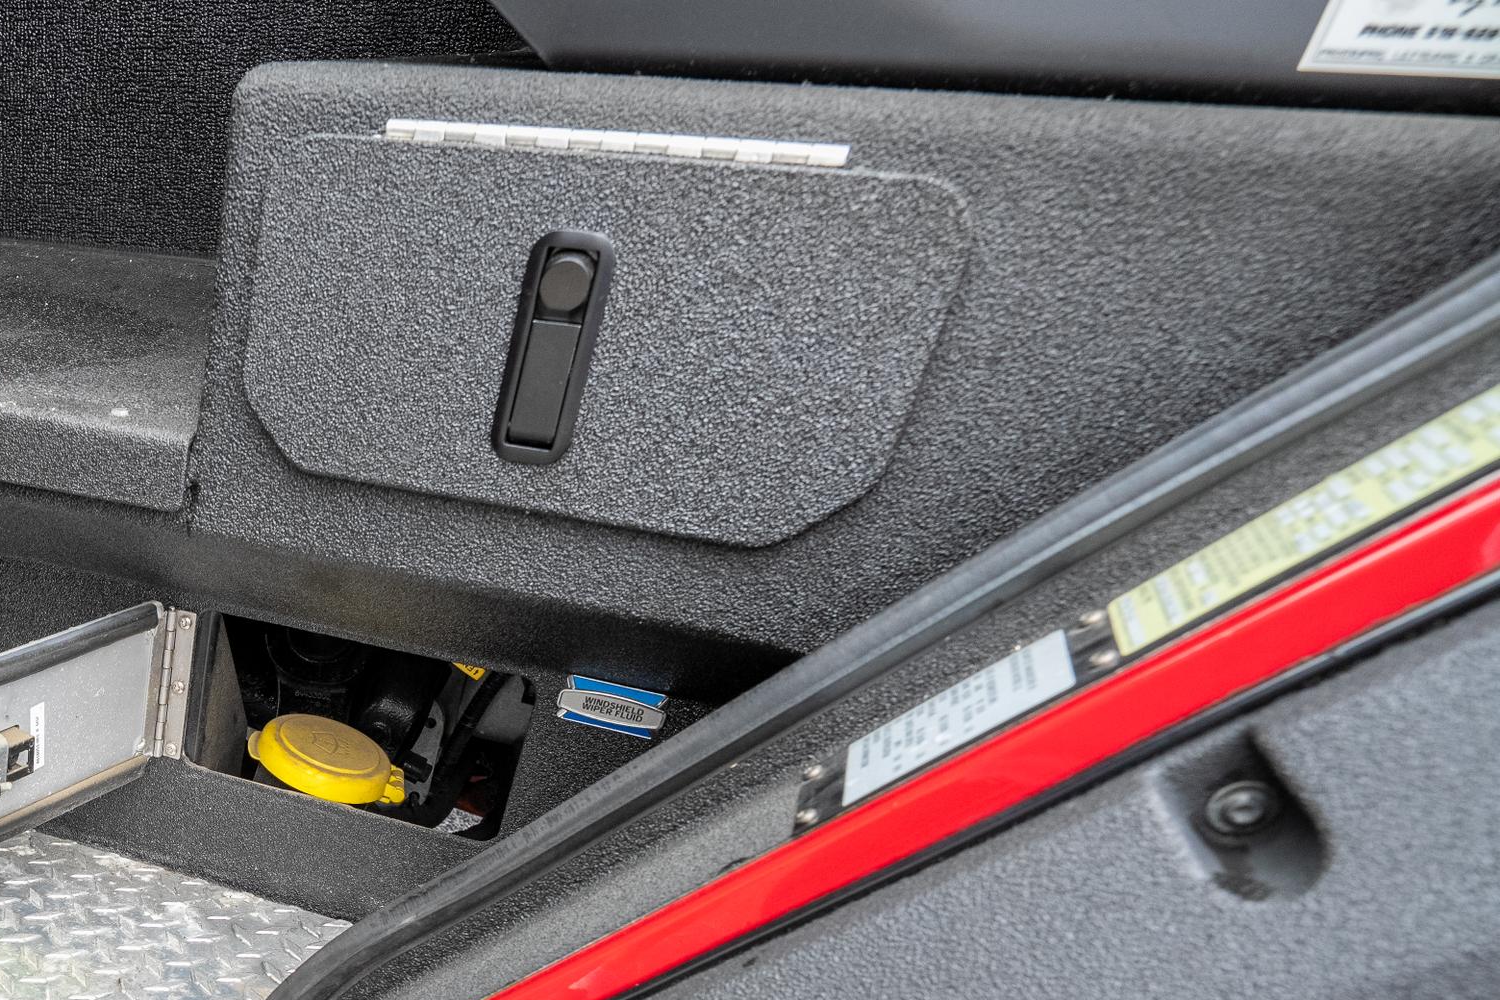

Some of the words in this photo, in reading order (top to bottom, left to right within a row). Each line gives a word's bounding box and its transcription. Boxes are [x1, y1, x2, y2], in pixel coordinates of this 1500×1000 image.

[581, 701, 612, 716] WIPER
[614, 709, 644, 723] FLUID
[584, 695, 645, 716] WINDSHIELD
